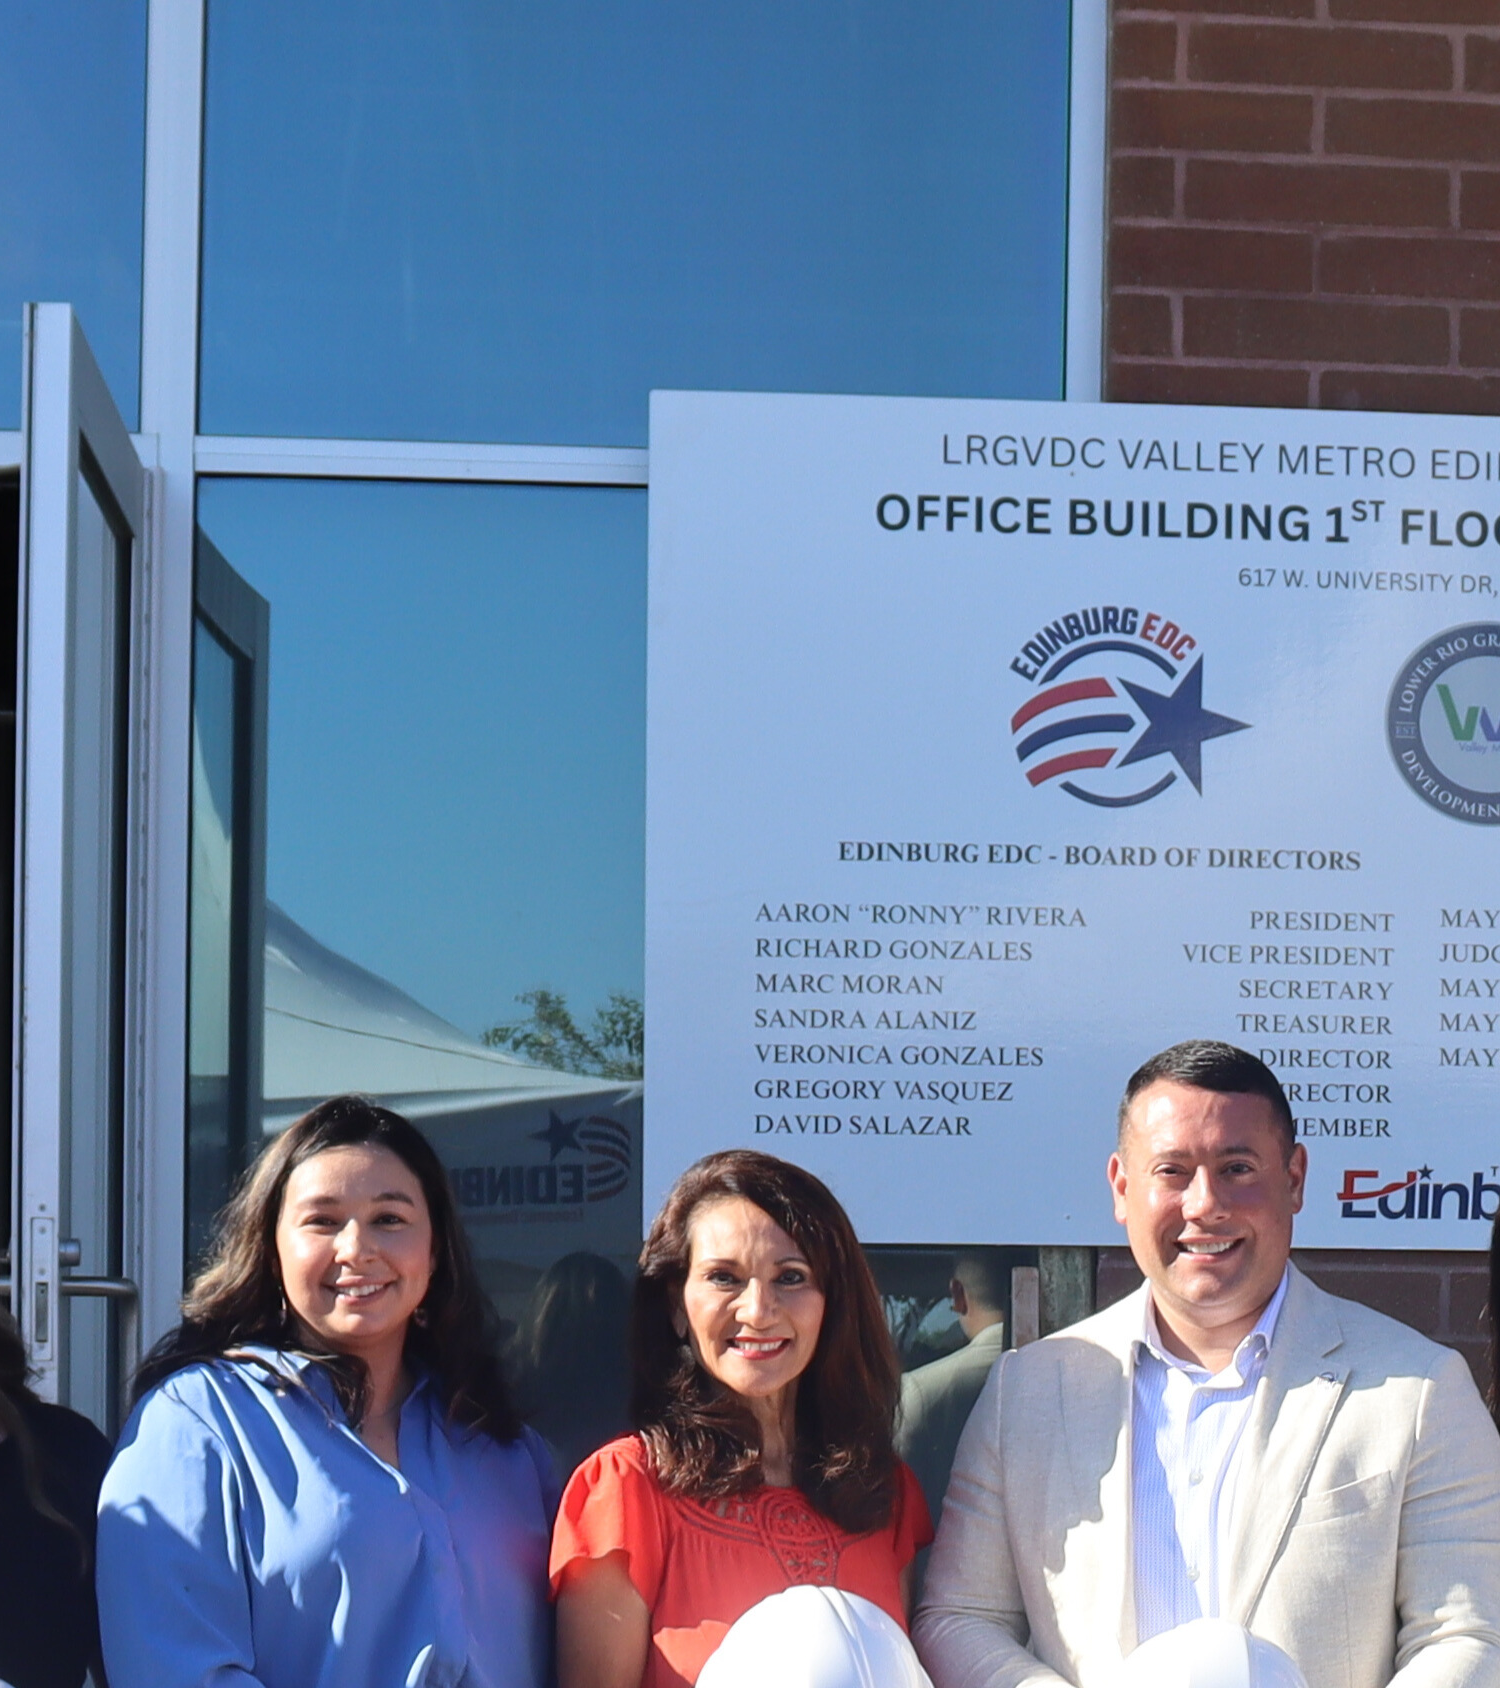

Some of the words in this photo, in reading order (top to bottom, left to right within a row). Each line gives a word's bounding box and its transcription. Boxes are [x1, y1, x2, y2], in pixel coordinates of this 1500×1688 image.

[943, 434, 1105, 469] LRGVDC
[1118, 439, 1264, 473] VALLEY
[1279, 444, 1415, 478] METRO
[876, 493, 1052, 535] OFFICE
[1069, 499, 1310, 542] BUILDING
[1239, 568, 1276, 587] 617
[1283, 570, 1308, 588] W.
[1317, 571, 1453, 592] UNIVERSITY
[1461, 575, 1498, 598] DR,
[1009, 605, 1139, 682] EDINBURG
[1139, 612, 1197, 662] EDC
[1399, 655, 1439, 713] LOWER
[1436, 637, 1468, 661] RIO
[839, 842, 979, 863] EDINBURG
[988, 844, 1042, 864] EDC
[1065, 846, 1157, 866] BOARD
[1164, 848, 1200, 867] OF
[1208, 849, 1360, 870] DIRECTORS
[755, 903, 850, 923] AARON
[859, 905, 980, 925] “RONNY”
[987, 907, 1086, 927] RIVERA
[1251, 911, 1394, 932] PRESIDENT
[756, 938, 882, 959] RICHARD
[889, 940, 1032, 961] GONZALES
[1183, 944, 1242, 963] VICE
[1250, 946, 1394, 966] PRESIDENT
[756, 974, 834, 994] MARC
[842, 975, 943, 994] MORAN
[1240, 979, 1393, 1000] SECRETARY
[755, 1009, 866, 1029] SANDRA
[875, 1011, 976, 1030] ALANIZ
[1236, 1014, 1392, 1035] TREASURER
[755, 1044, 893, 1065] VERONICA
[900, 1046, 1043, 1066] GONZALES
[1259, 1048, 1392, 1070] DIRECTOR
[754, 1079, 886, 1100] GREGORY
[893, 1080, 1013, 1105] VASQUEZ
[1279, 1083, 1392, 1104] RECTOR
[755, 1115, 842, 1134] DAVID
[849, 1115, 972, 1135] SALAZAR
